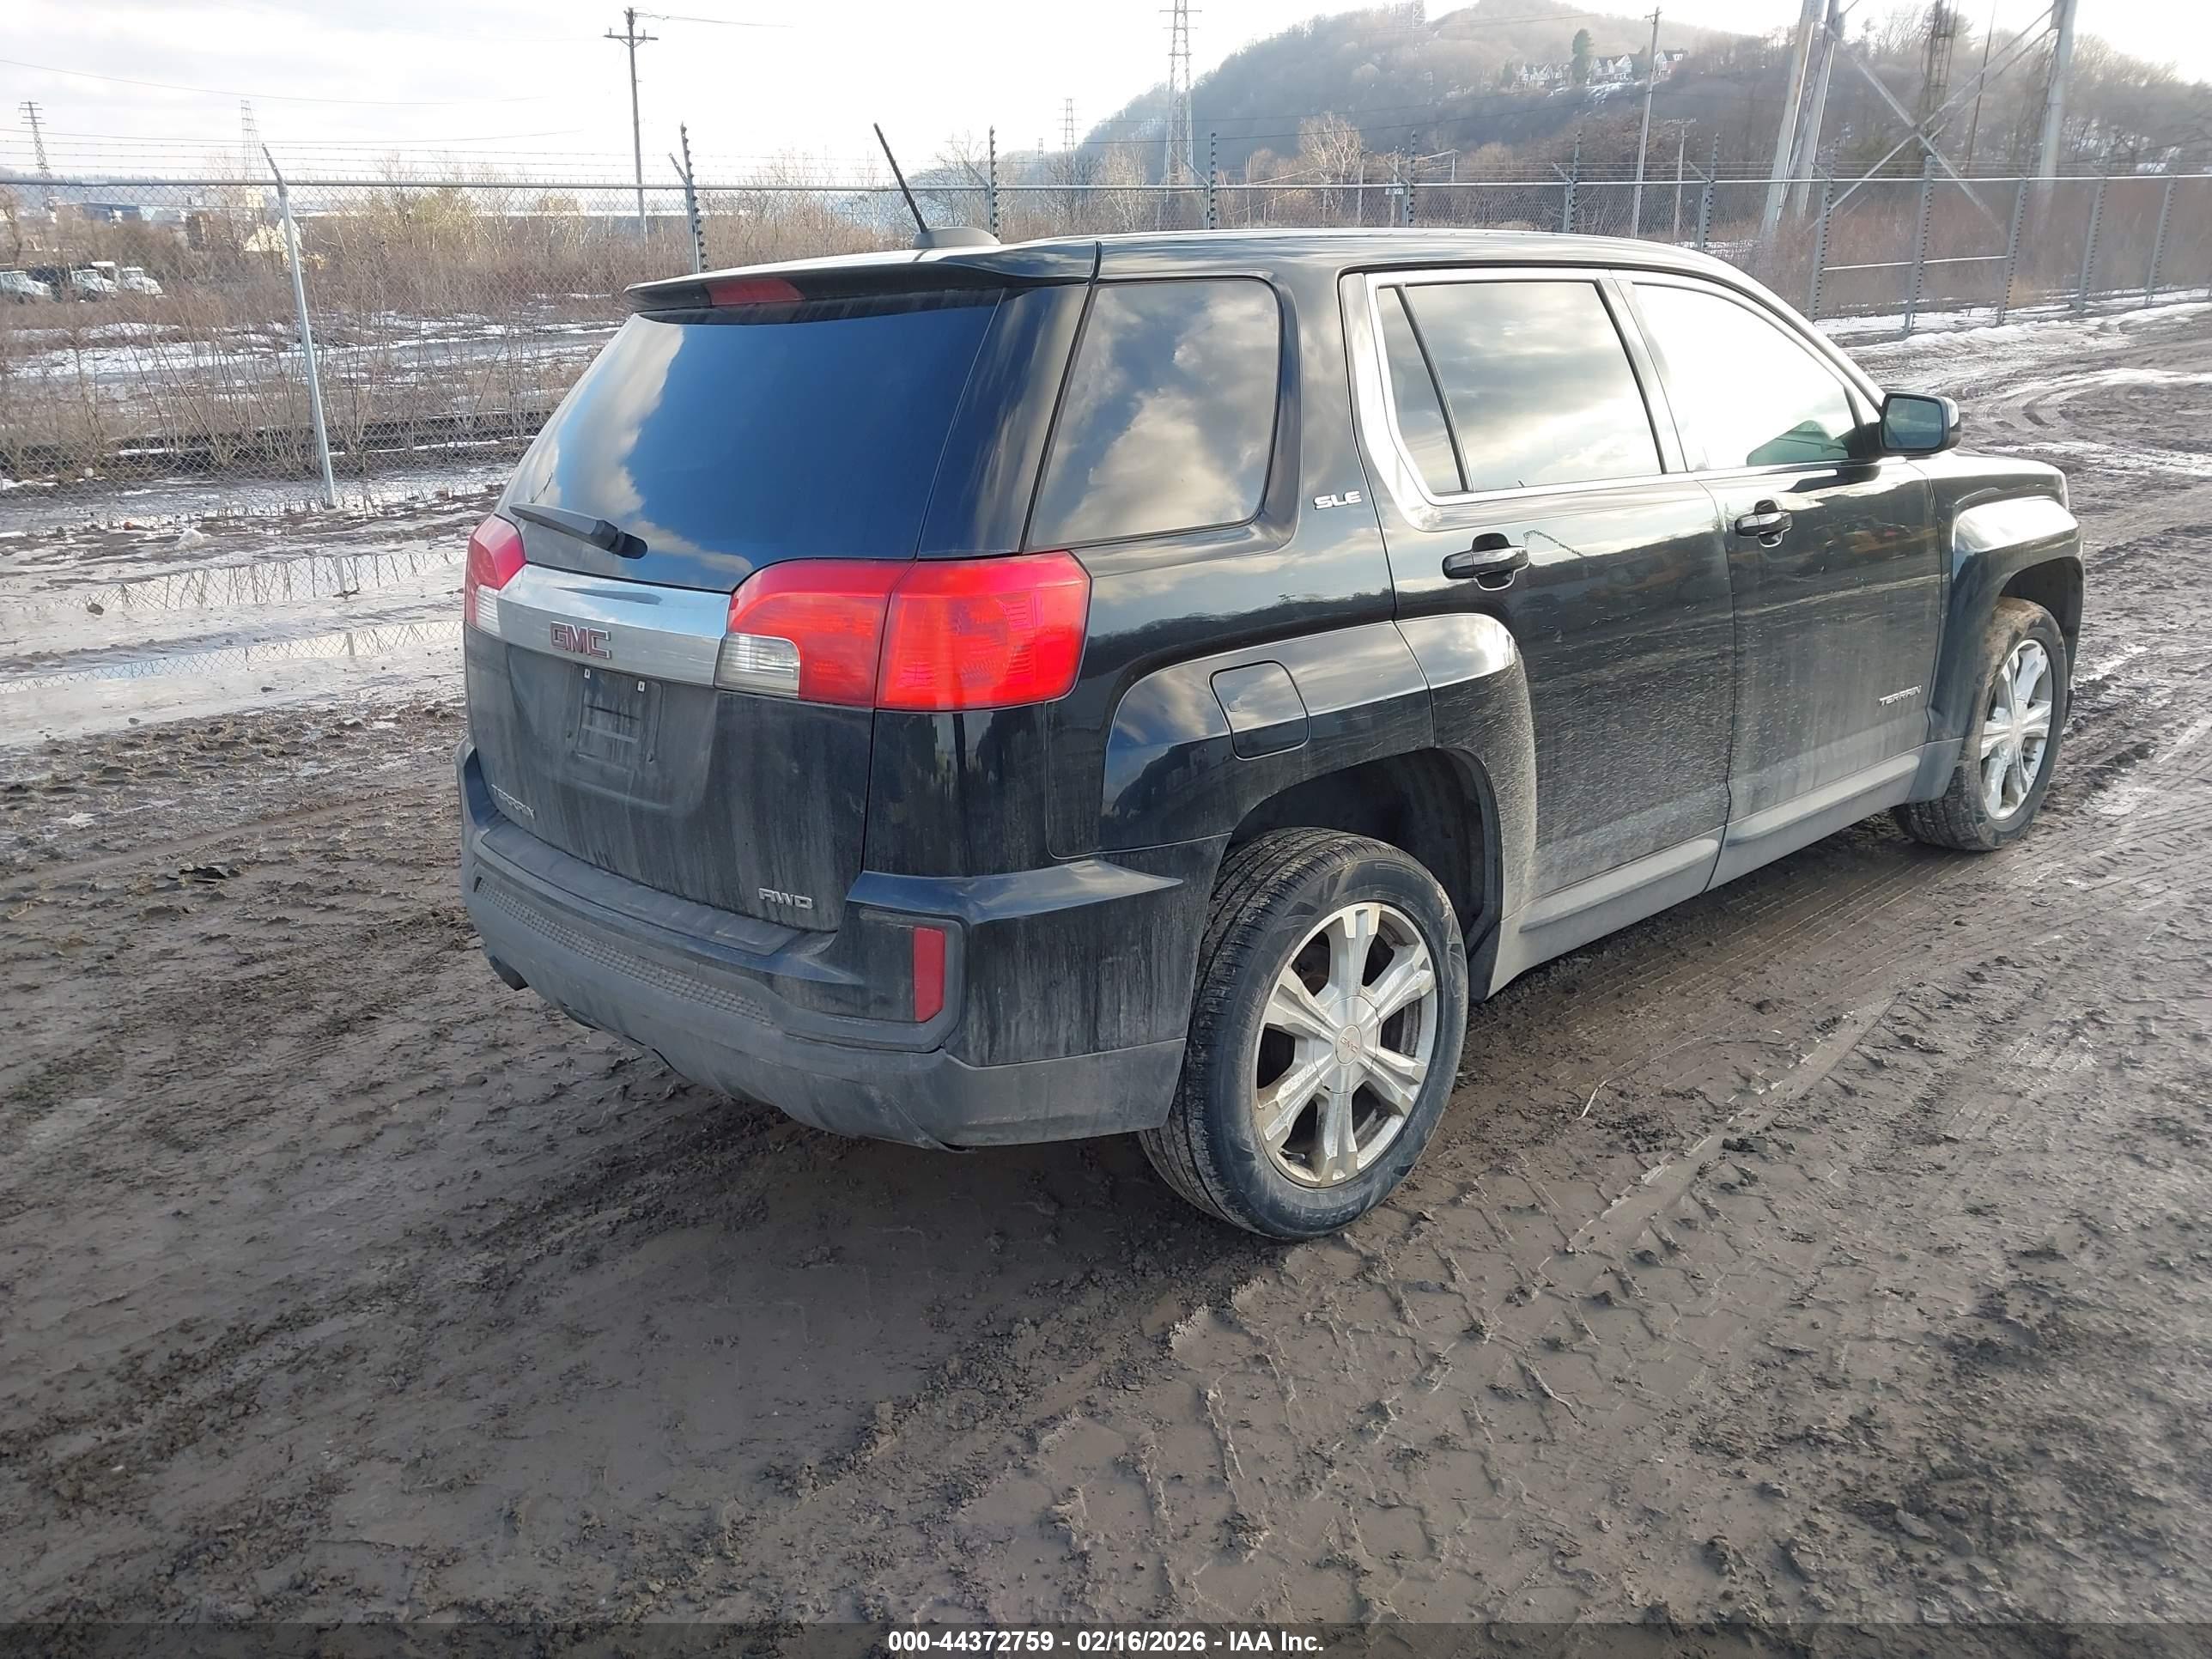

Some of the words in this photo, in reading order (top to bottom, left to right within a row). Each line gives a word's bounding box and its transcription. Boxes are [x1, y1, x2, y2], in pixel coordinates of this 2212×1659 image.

[1313, 490, 1362, 510] SLE
[550, 620, 612, 659] GMC
[758, 887, 813, 910] AWD
[1340, 1036, 1358, 1055] GMC
